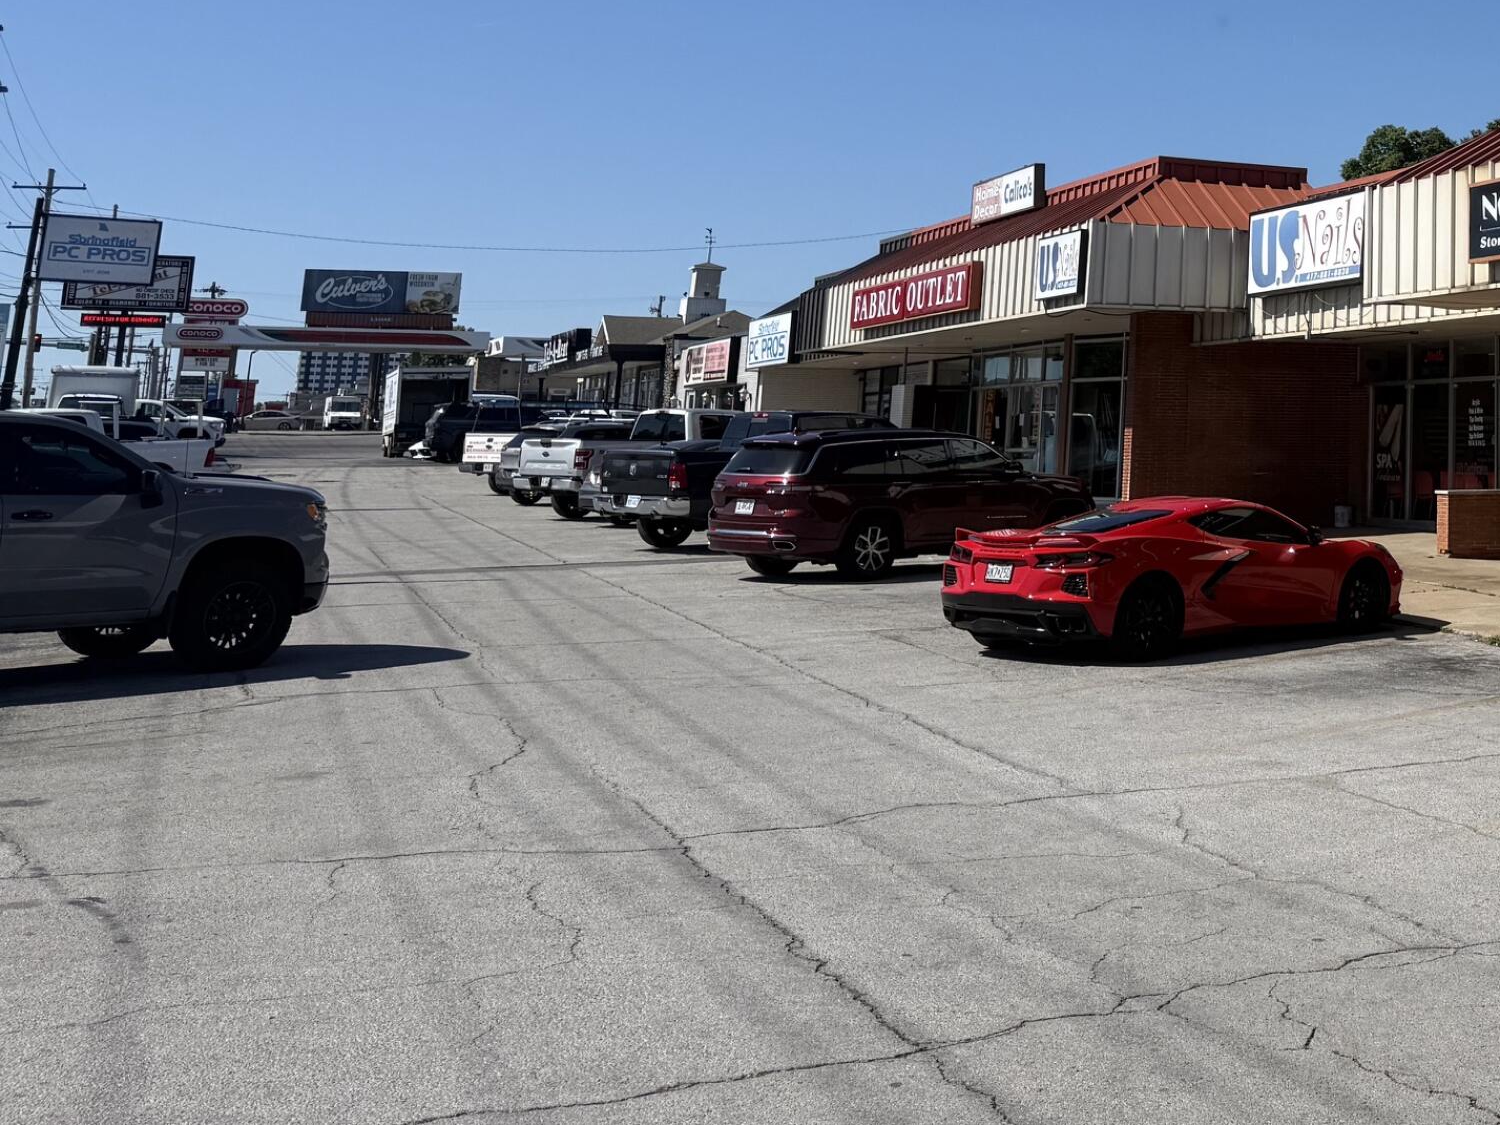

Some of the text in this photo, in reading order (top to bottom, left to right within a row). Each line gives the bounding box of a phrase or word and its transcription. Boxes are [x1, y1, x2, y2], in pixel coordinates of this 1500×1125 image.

[975, 185, 1000, 202] Home
[1003, 177, 1033, 204] Calico's
[974, 202, 999, 220] Decor
[69, 233, 138, 247] Springfield
[52, 245, 147, 263] PC PROS
[315, 273, 388, 303] Culver's
[853, 270, 967, 323] FABRIC OUTLET
[749, 339, 759, 362] PC
[761, 335, 786, 359] PROS
[1376, 452, 1393, 469] SPA
